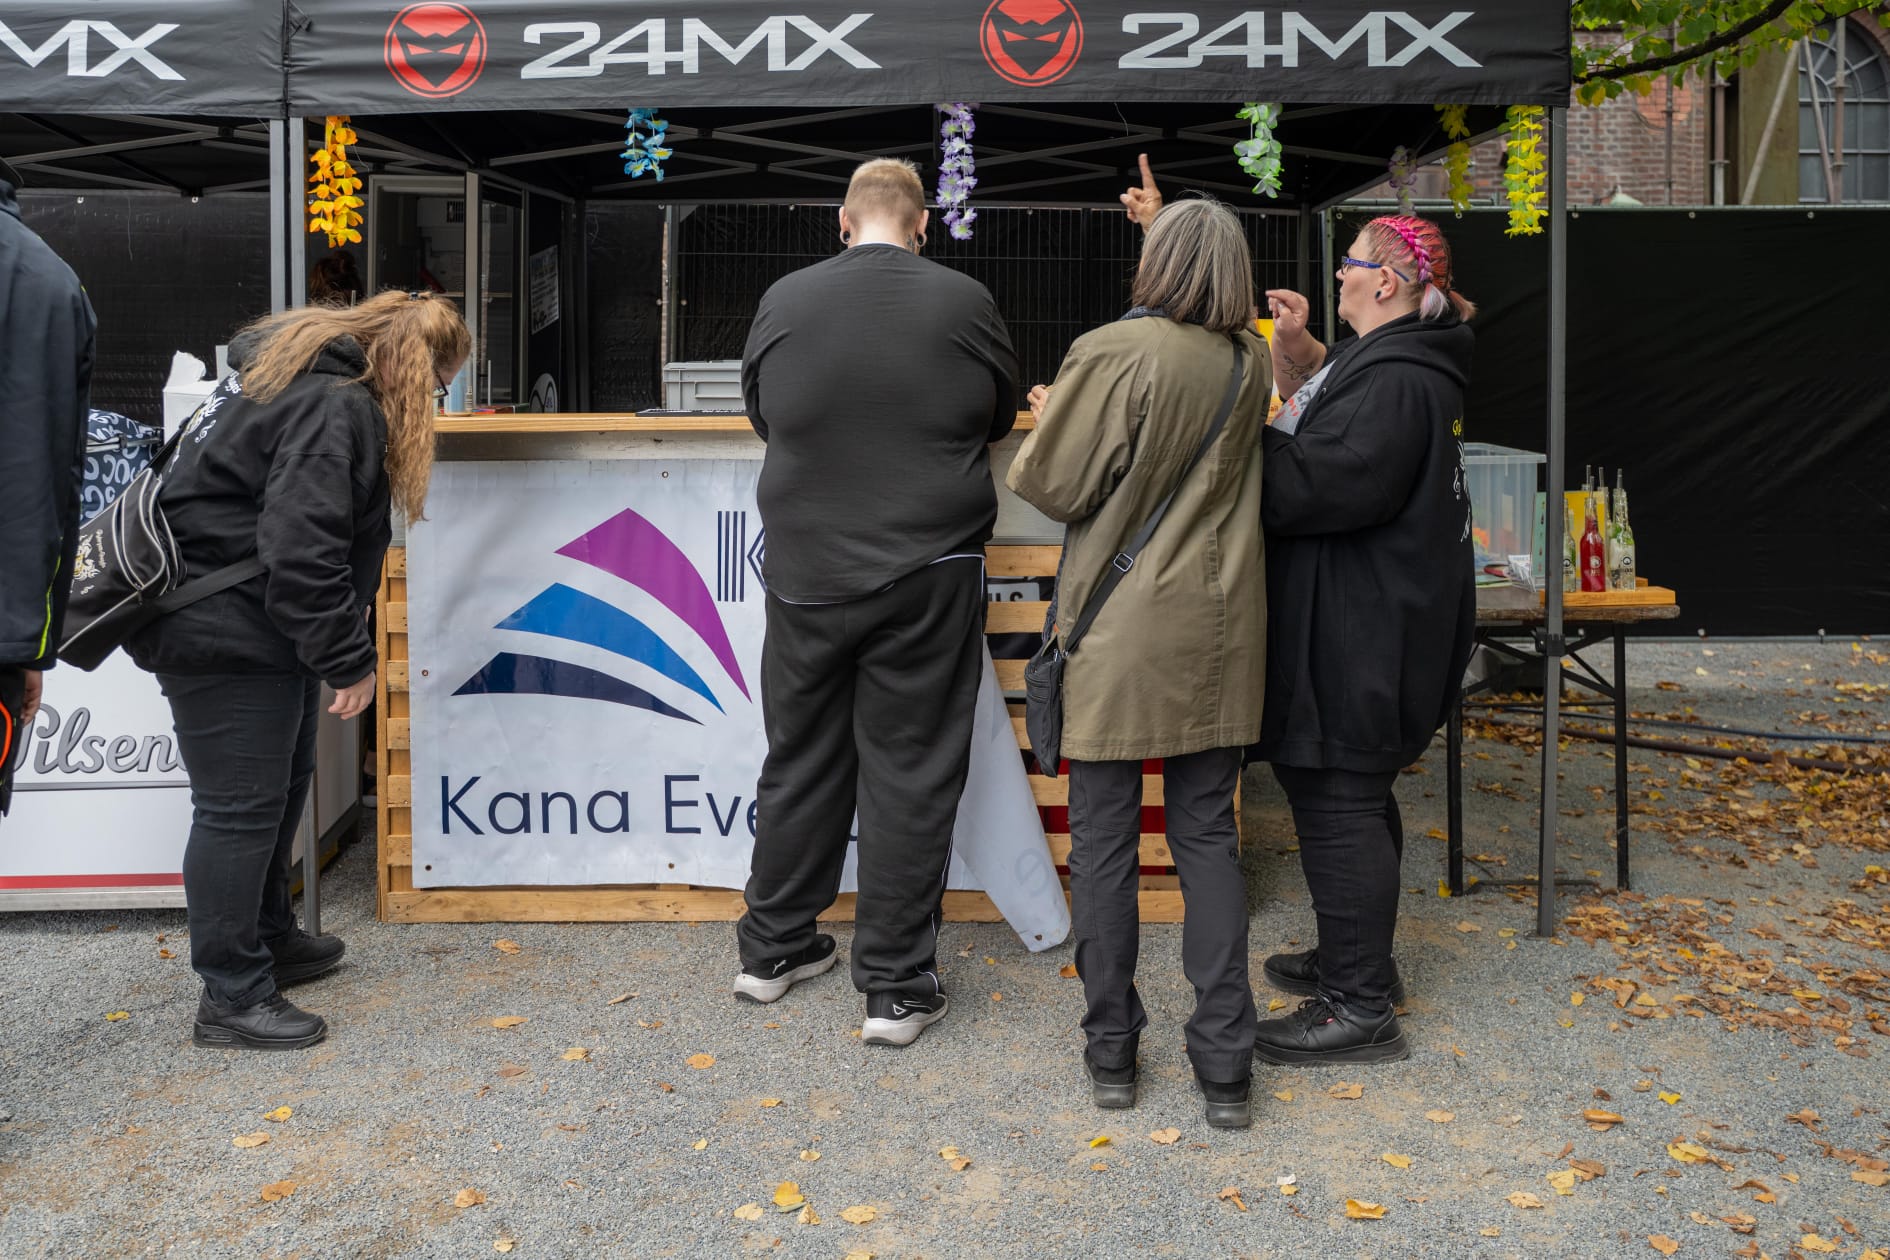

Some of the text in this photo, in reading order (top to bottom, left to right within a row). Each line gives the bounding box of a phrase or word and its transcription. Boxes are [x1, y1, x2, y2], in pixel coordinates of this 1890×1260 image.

[520, 13, 883, 79] 24MX
[1118, 11, 1484, 68] 24MX
[441, 774, 757, 838] Kana Ev
